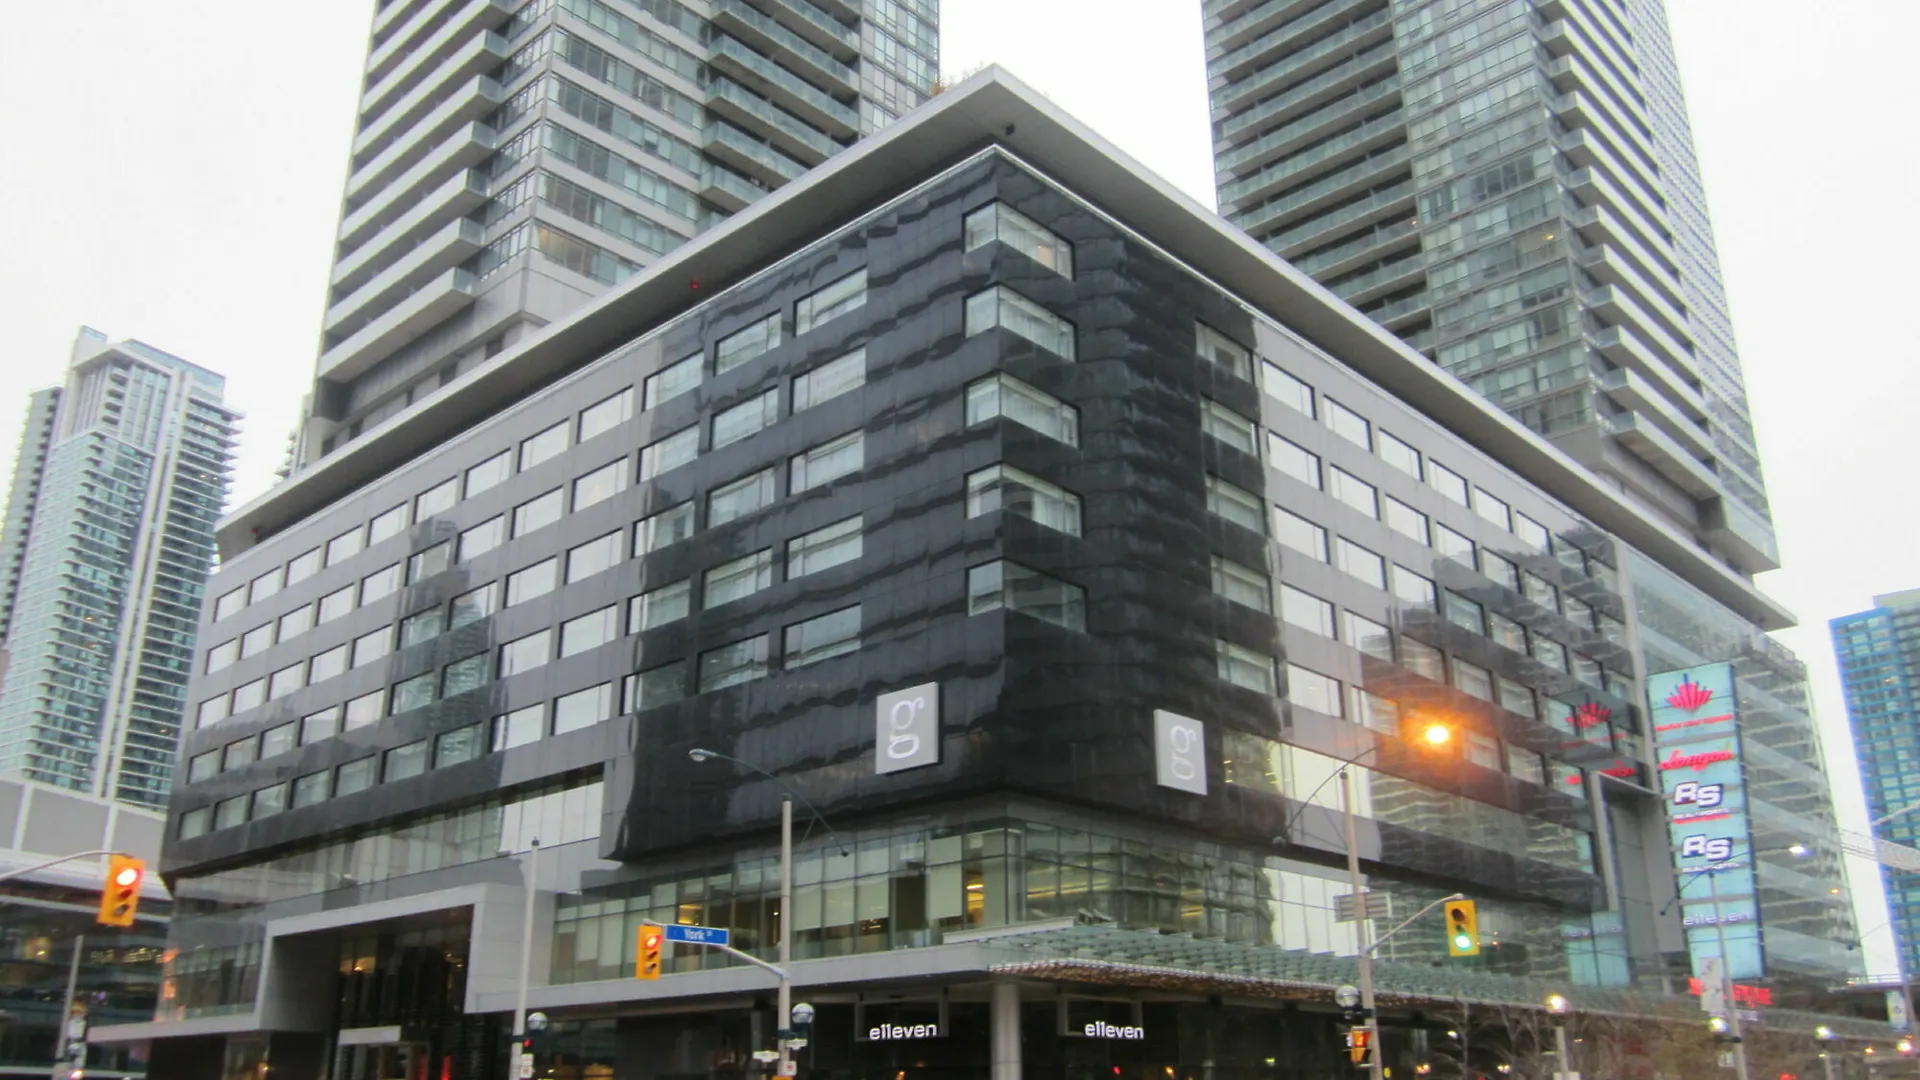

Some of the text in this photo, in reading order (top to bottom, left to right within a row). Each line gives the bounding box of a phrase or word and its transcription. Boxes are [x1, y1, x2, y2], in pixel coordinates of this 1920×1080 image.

[887, 697, 925, 759] g
[1170, 725, 1197, 780] g
[684, 929, 704, 940] York
